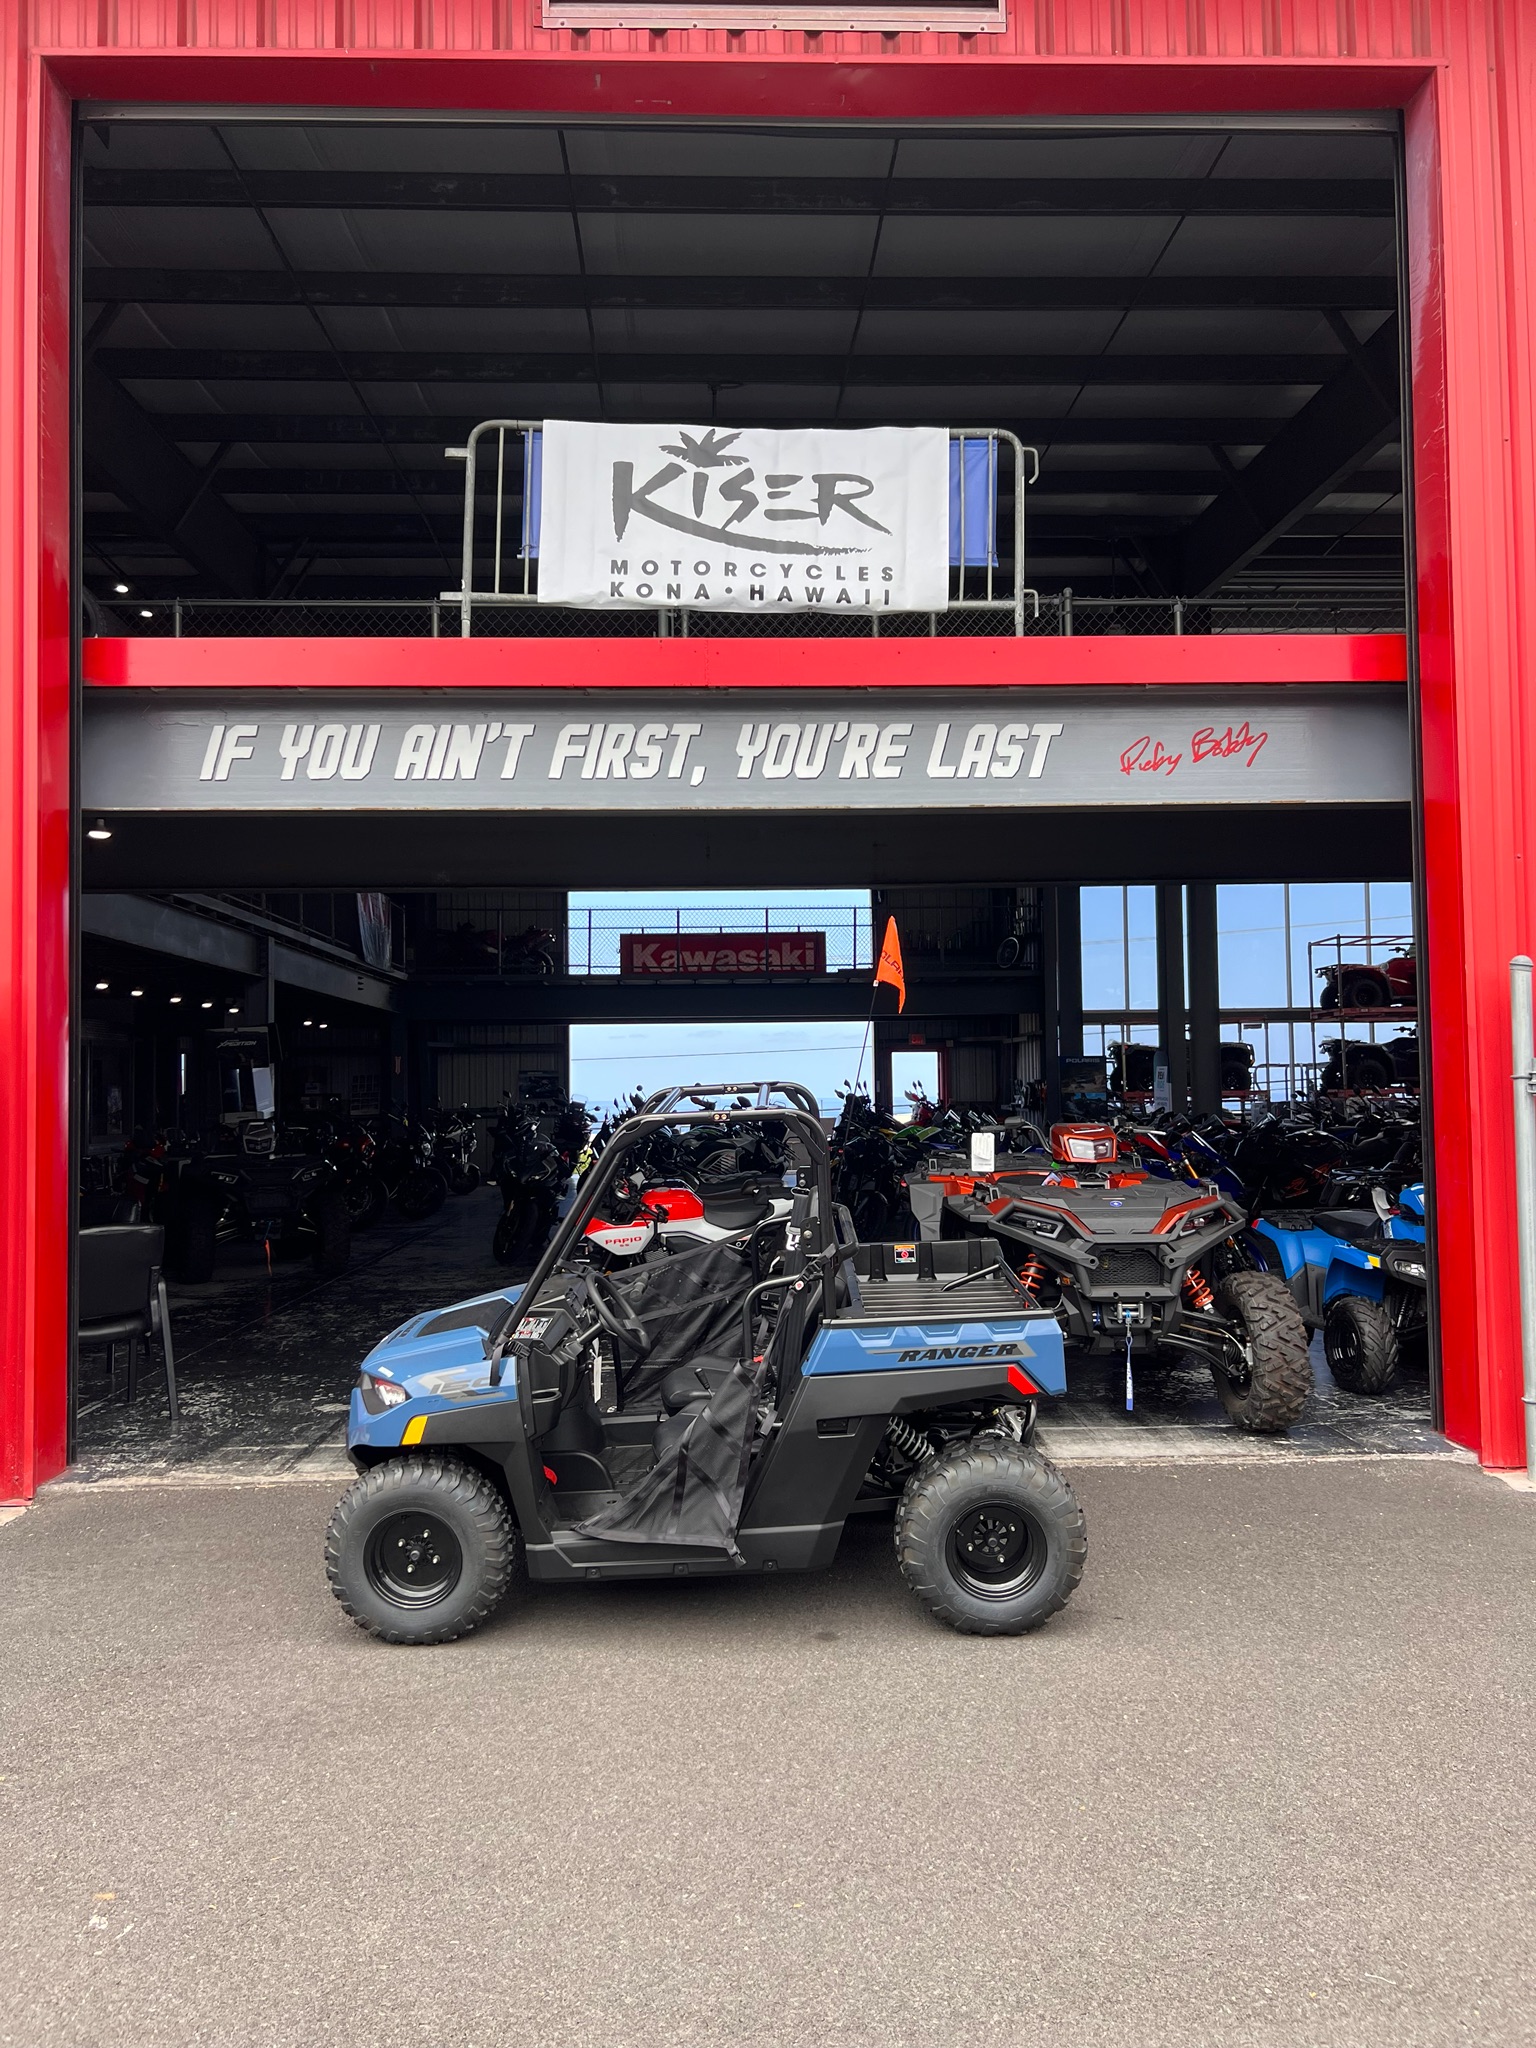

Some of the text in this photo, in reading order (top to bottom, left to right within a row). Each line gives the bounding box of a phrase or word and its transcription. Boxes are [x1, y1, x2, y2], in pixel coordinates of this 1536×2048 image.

[612, 461, 892, 556] KISER
[610, 560, 894, 582] MOTORCYCLES
[610, 581, 892, 606] KONA HAWAII
[200, 722, 1064, 787] IF YOU AIN'T FIRST, YOU'RE LAST
[632, 941, 815, 973] Kawasaki
[605, 1236, 642, 1245] PAPIO
[897, 1343, 1018, 1363] RANGER
